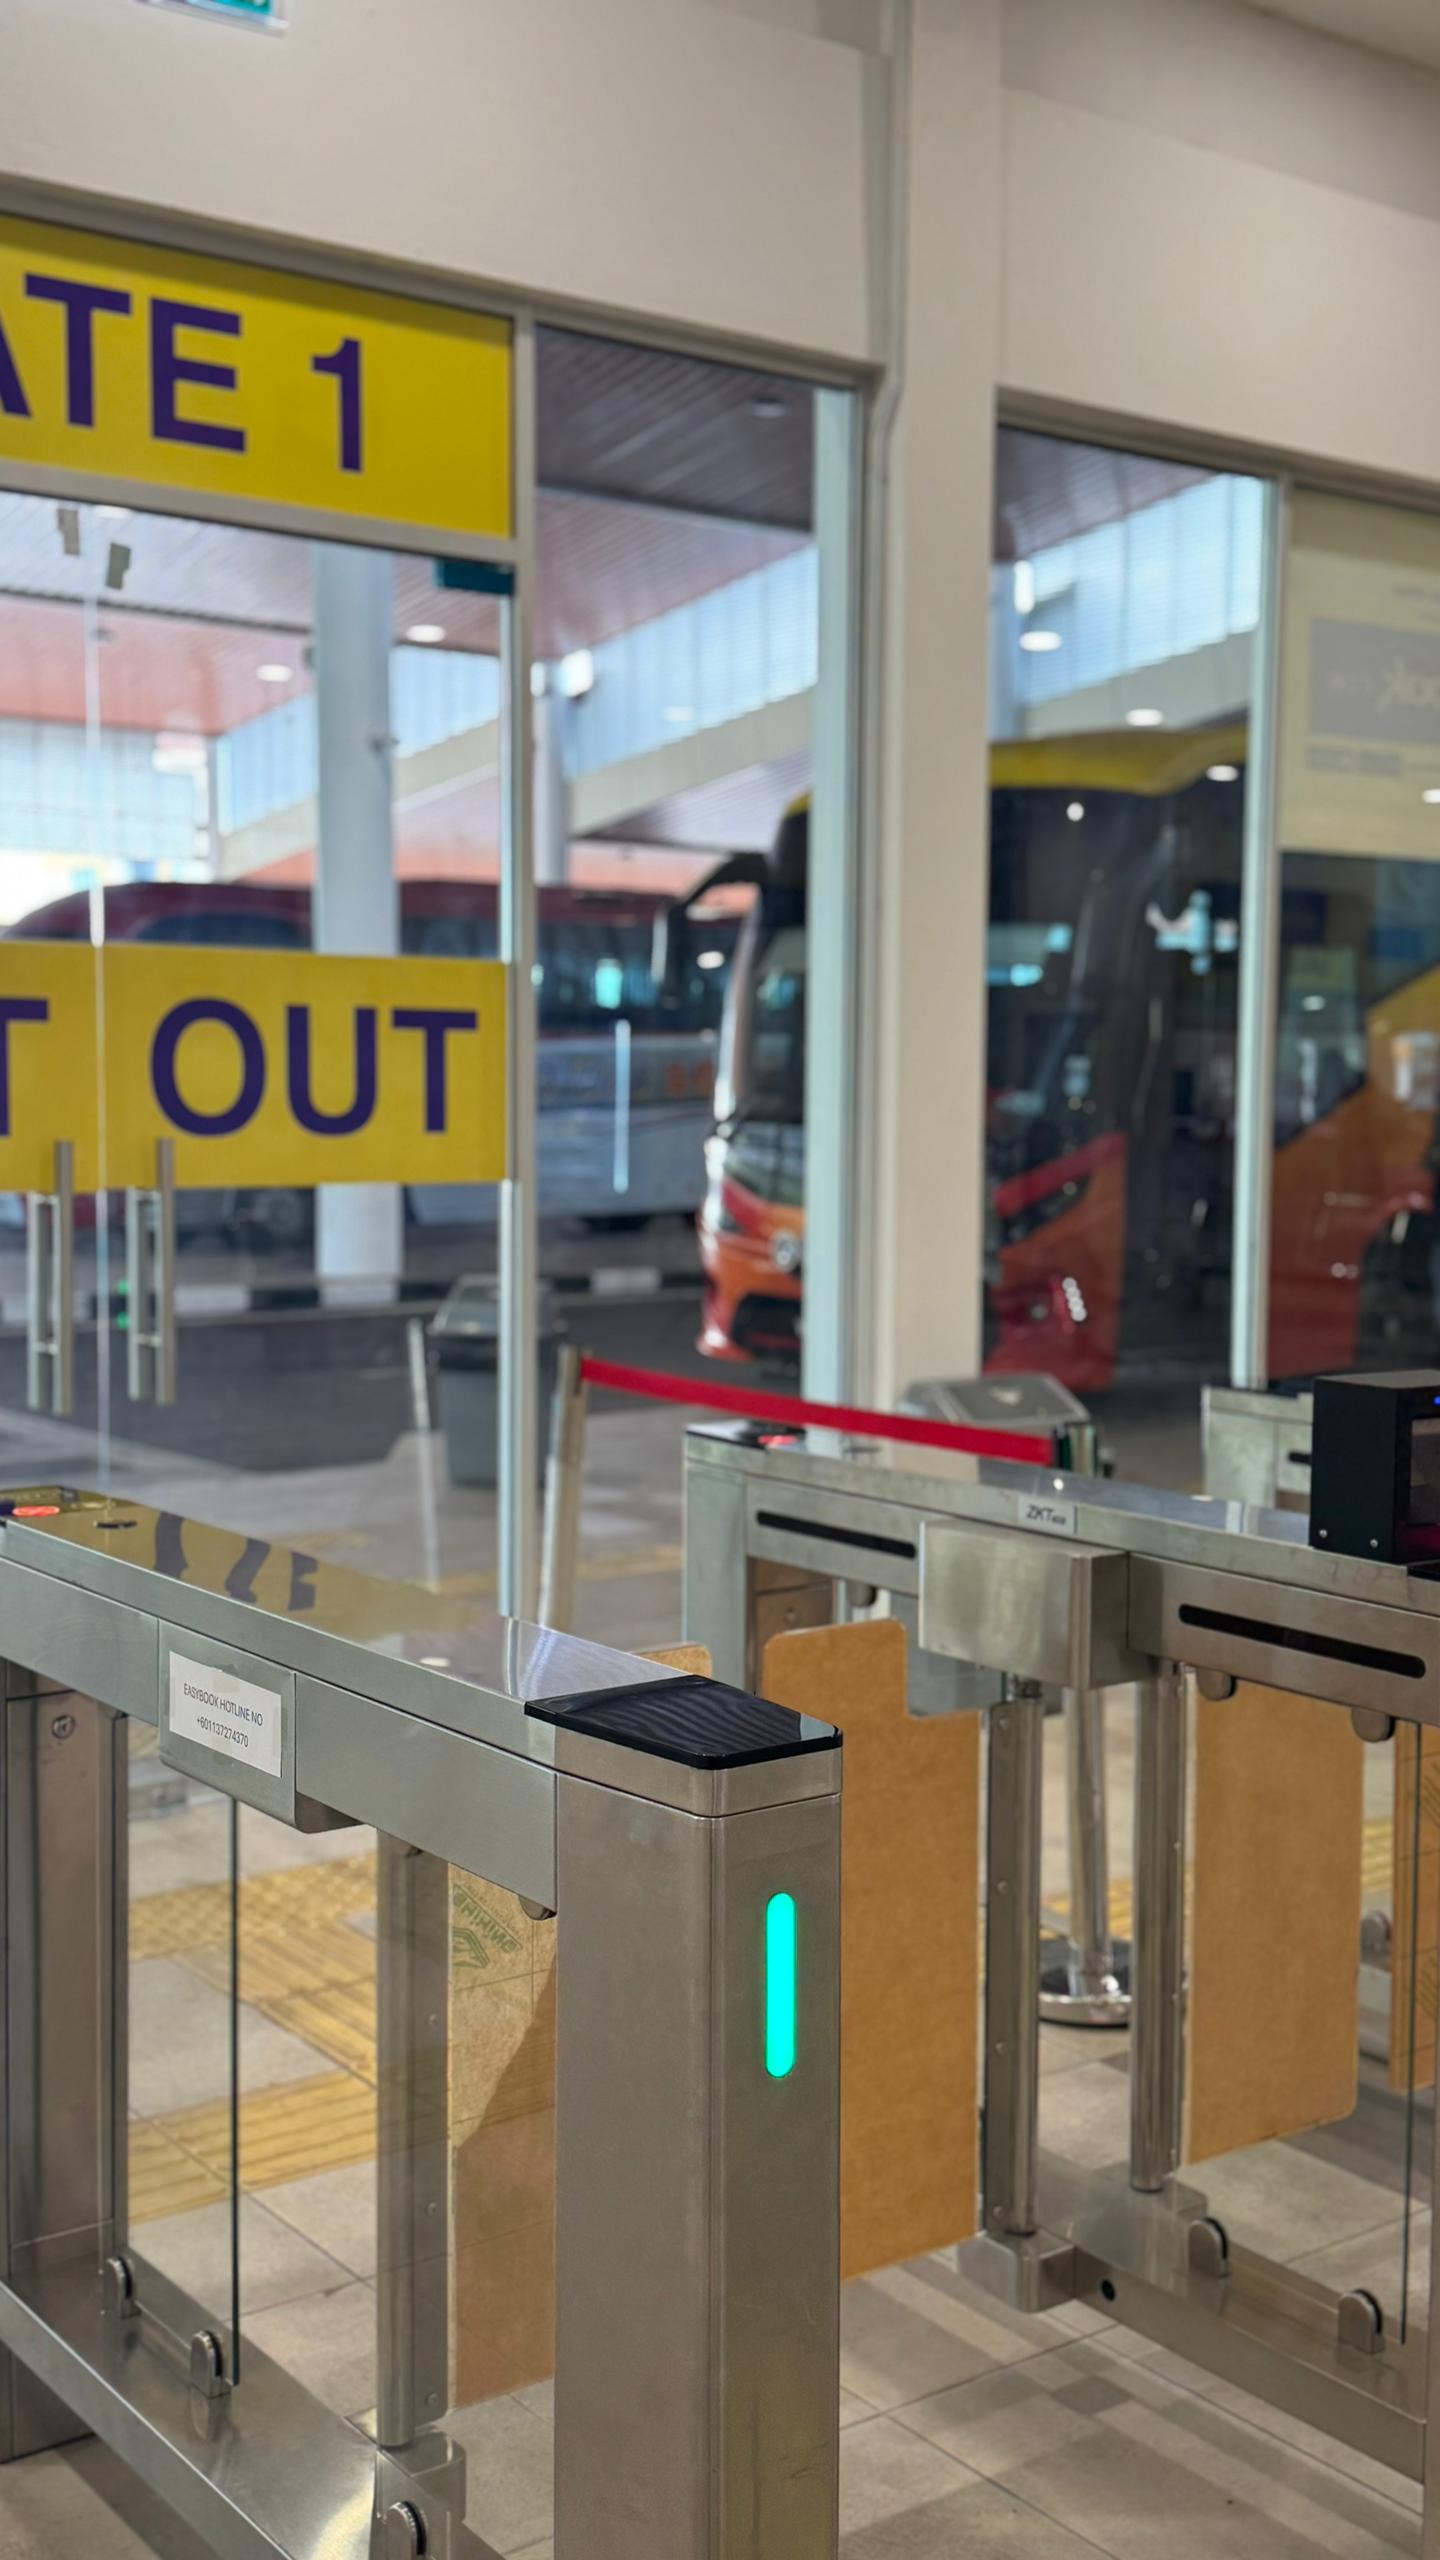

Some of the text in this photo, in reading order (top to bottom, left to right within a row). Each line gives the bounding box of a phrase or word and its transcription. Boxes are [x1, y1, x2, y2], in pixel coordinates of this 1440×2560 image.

[311, 336, 363, 474] 1
[151, 997, 478, 1137] OUT
[184, 1683, 263, 1727] EASYBOOK HOTLINE NO
